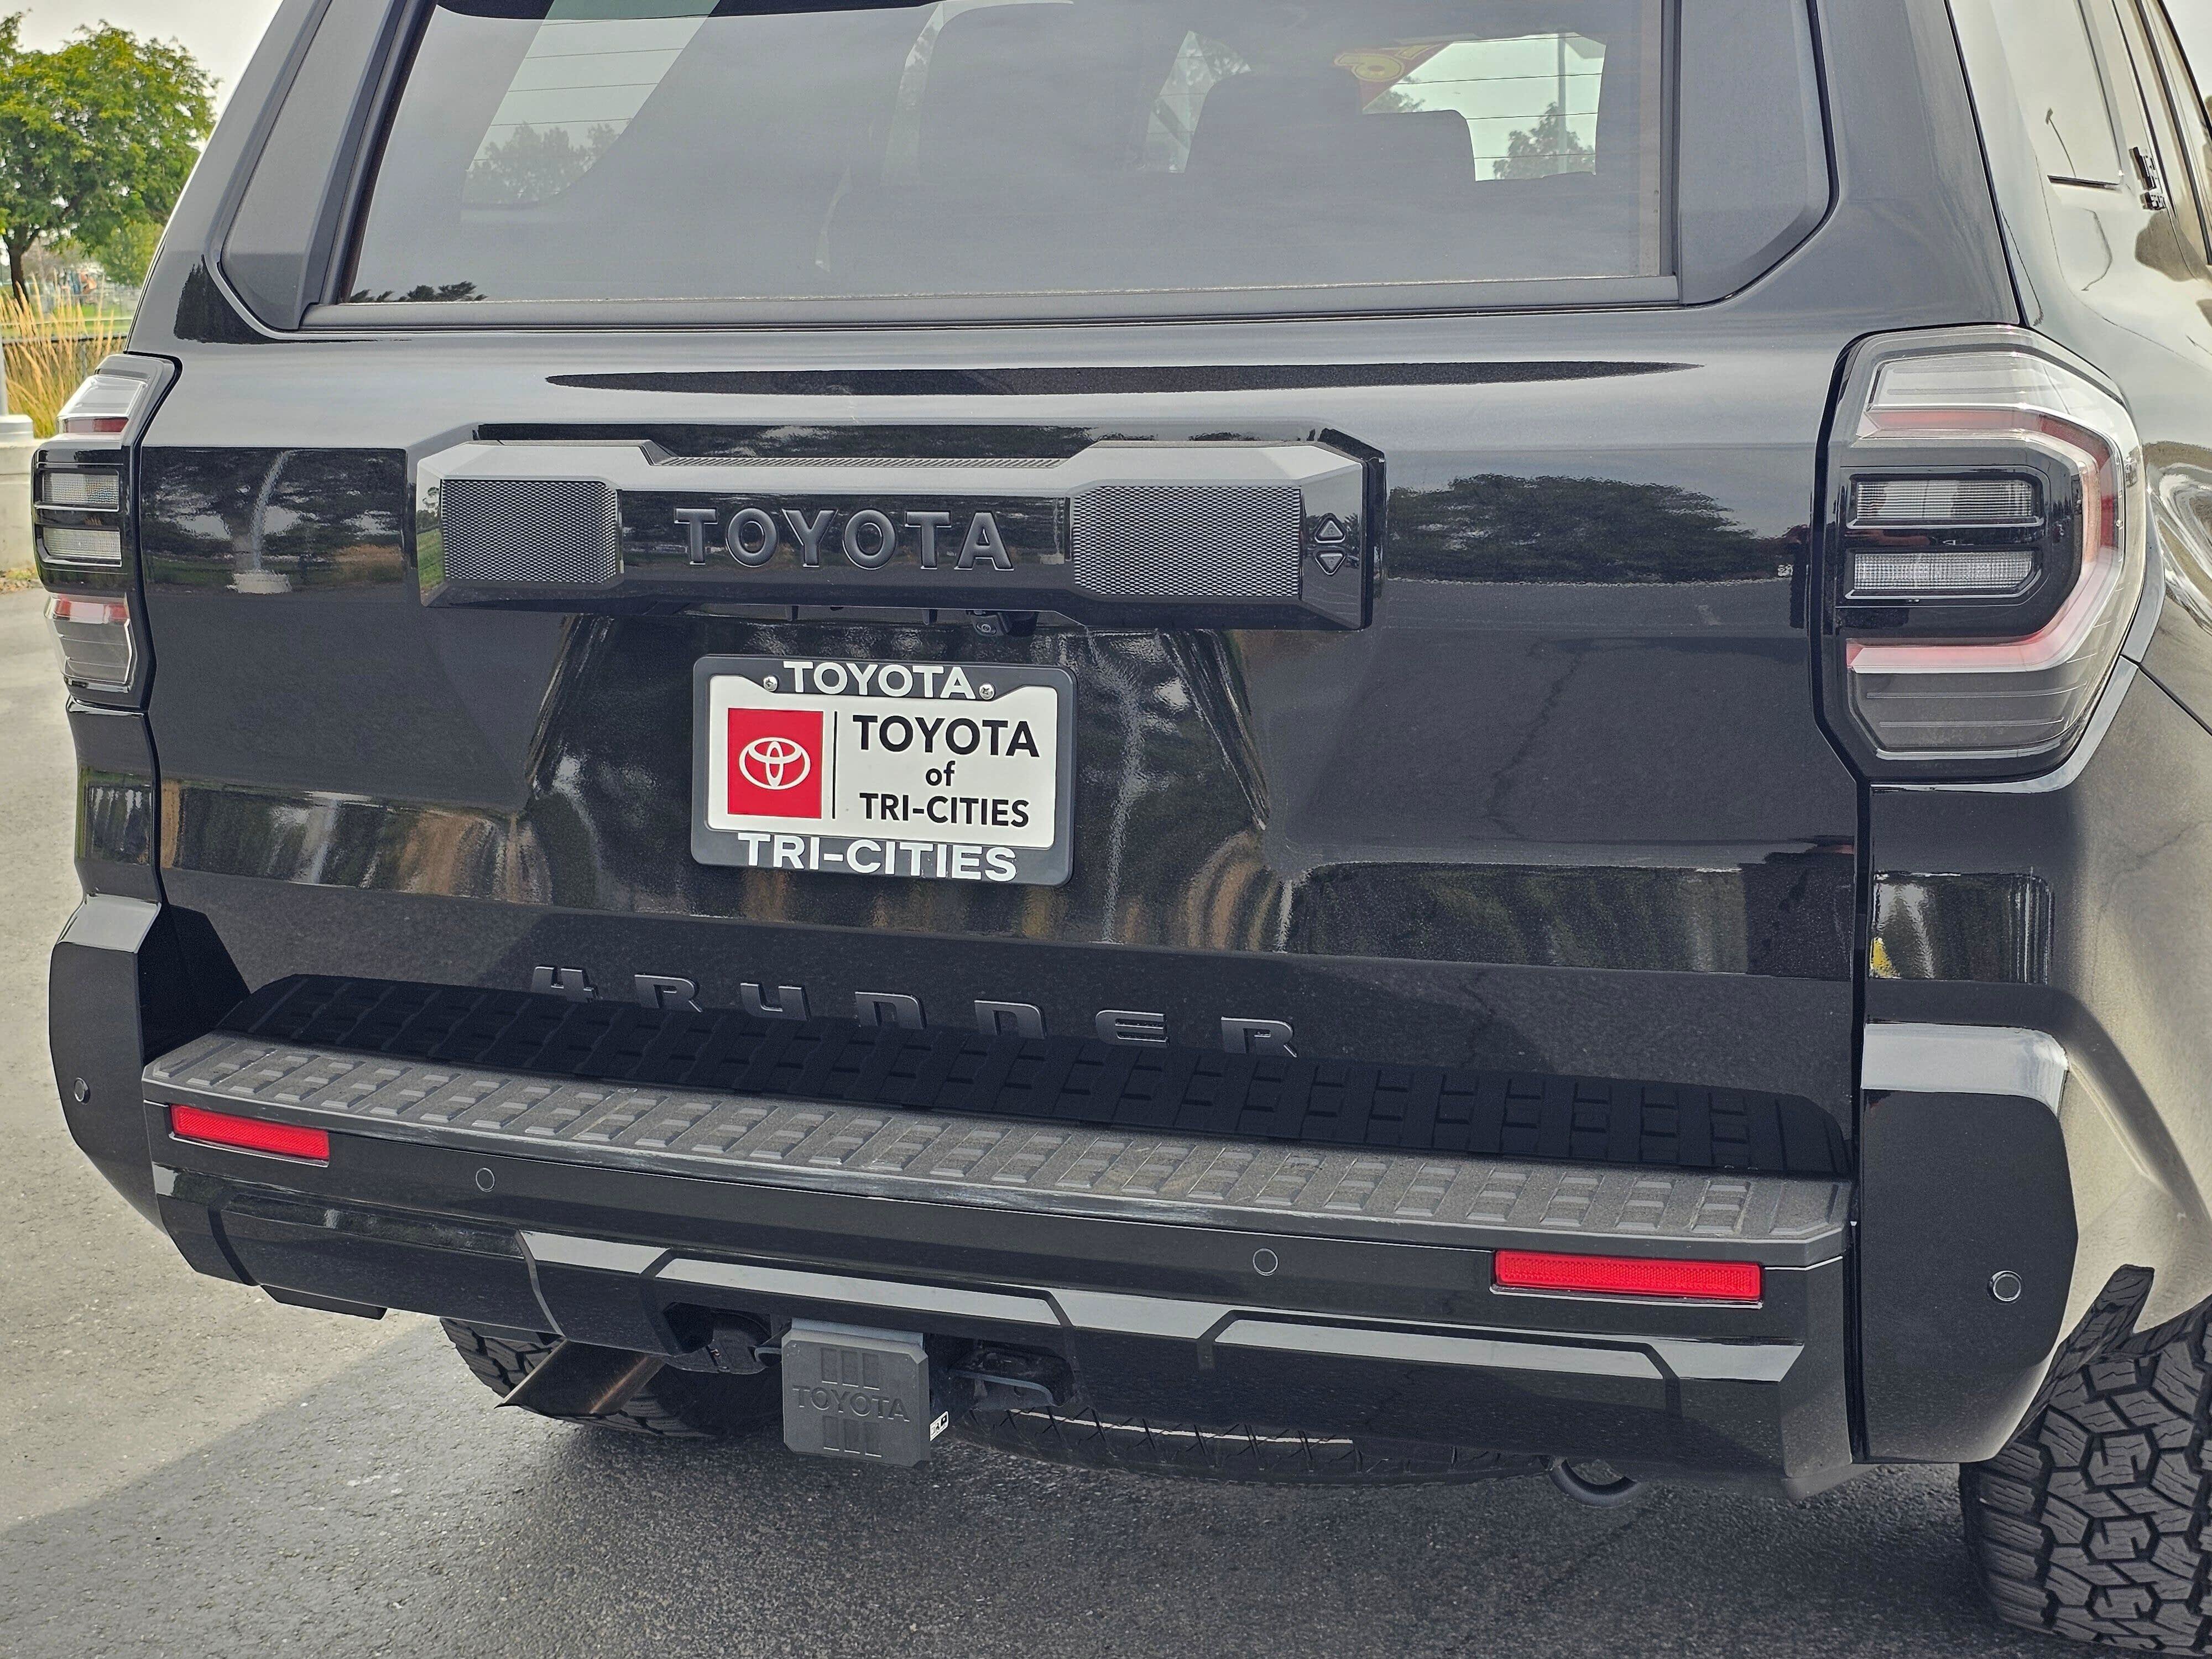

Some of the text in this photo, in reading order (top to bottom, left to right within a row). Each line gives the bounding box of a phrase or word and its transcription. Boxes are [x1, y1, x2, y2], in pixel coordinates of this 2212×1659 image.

[674, 507, 1014, 571] TOYOTA
[783, 661, 974, 699] TOYOTA
[853, 714, 1039, 758] TOYOTA
[926, 760, 954, 786] of
[859, 792, 1029, 828] TRI-CITIES
[738, 832, 1016, 881] TRI-CITIES
[792, 1385, 910, 1422] TOYOTA
